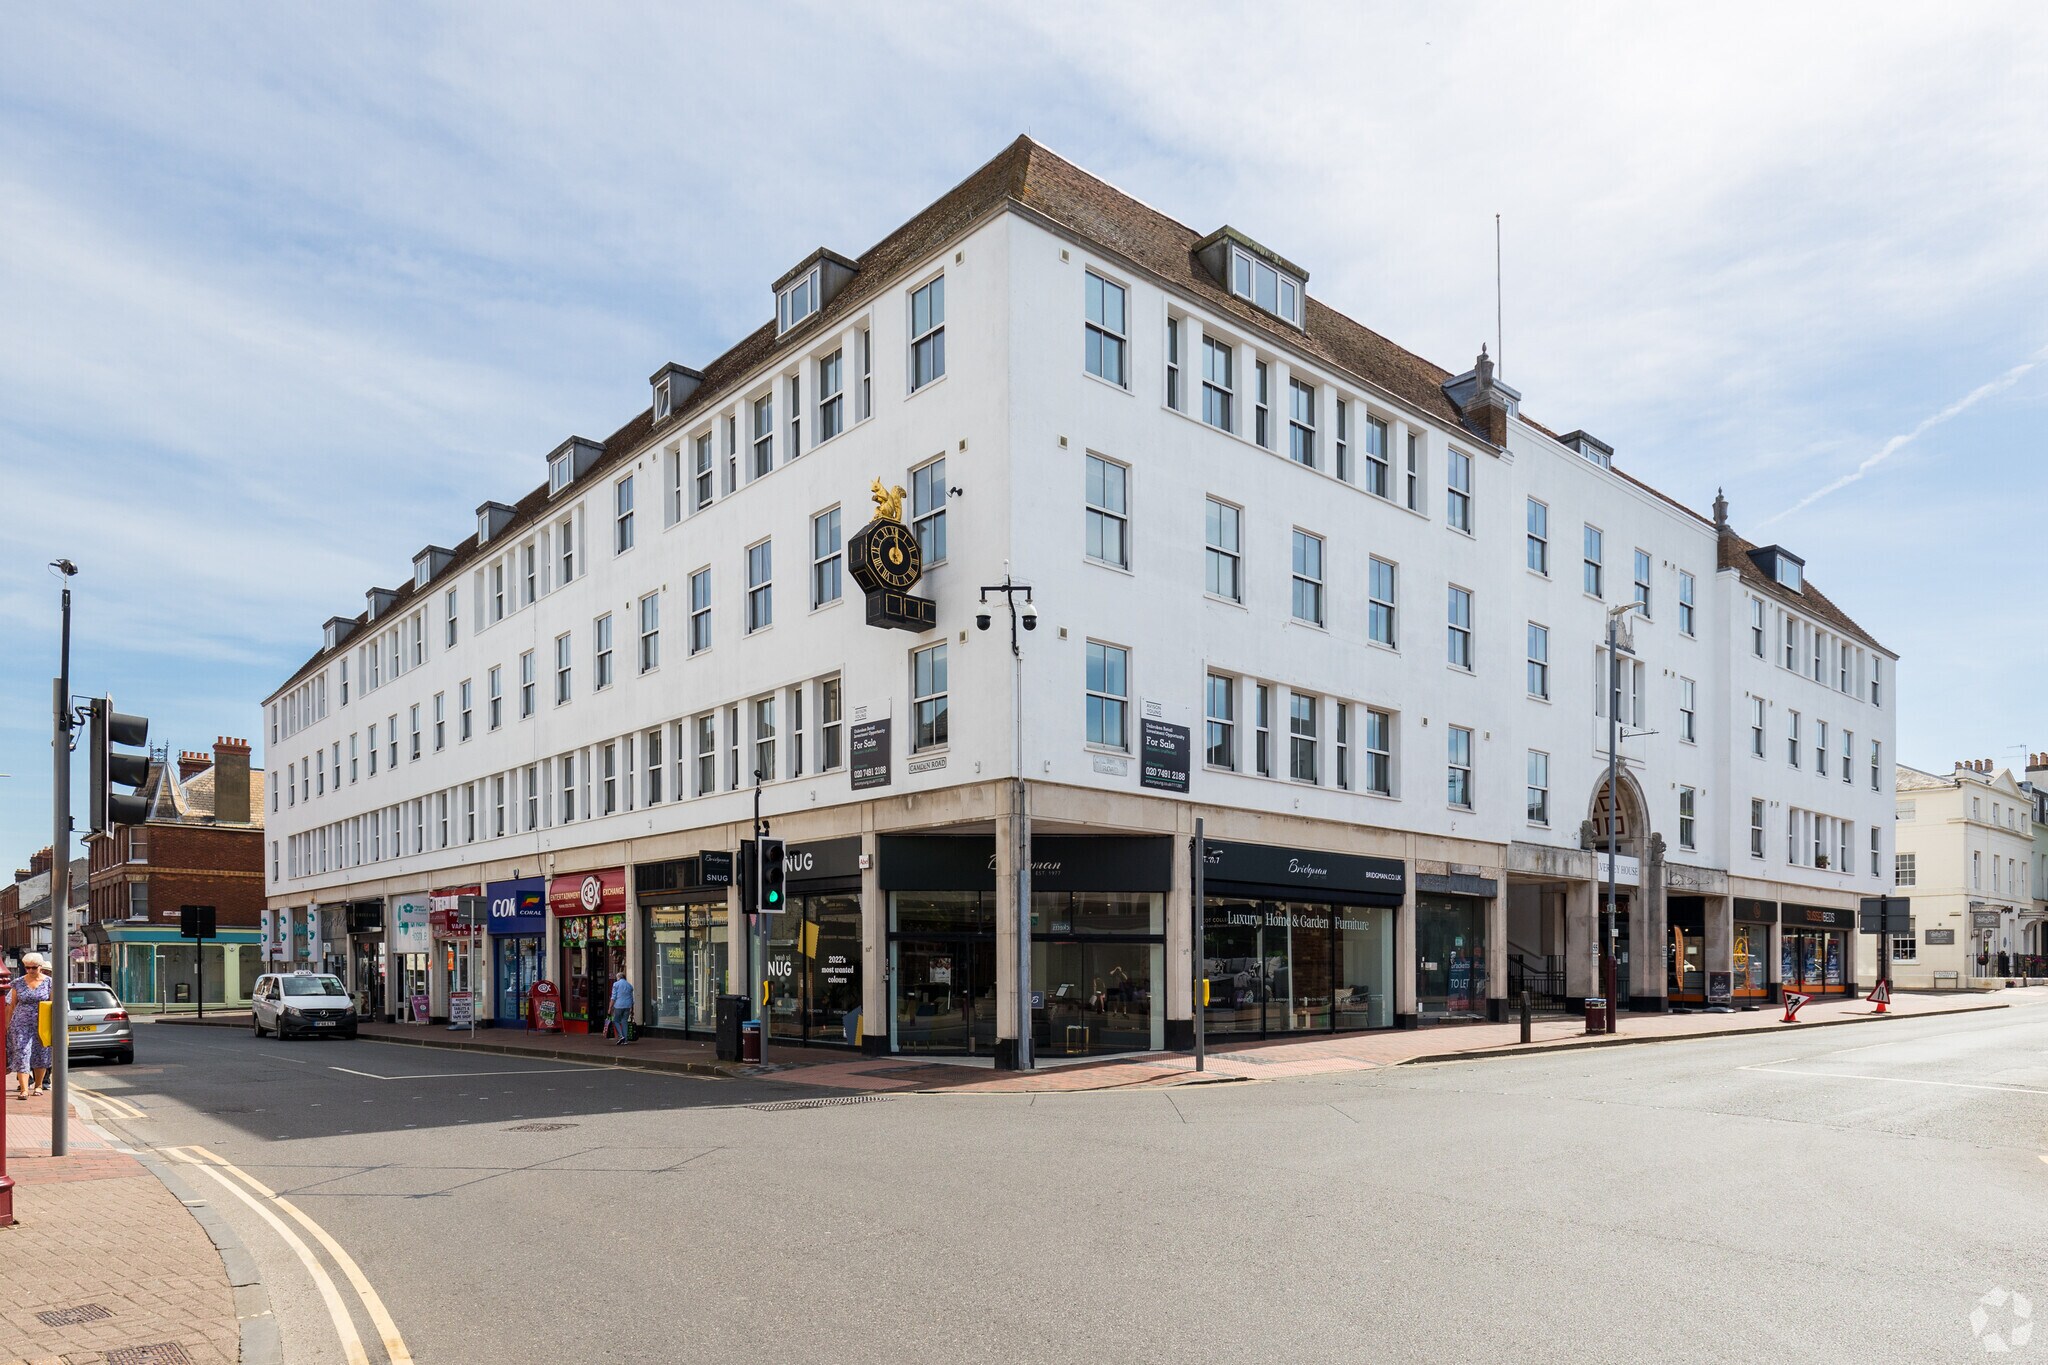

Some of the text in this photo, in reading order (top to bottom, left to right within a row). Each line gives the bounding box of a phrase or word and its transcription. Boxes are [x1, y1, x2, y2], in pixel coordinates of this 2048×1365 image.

[853, 738, 877, 750] For Sale
[1146, 736, 1158, 746] For
[1159, 739, 1175, 750] Sale
[931, 759, 946, 768] ROAD
[854, 770, 863, 779] 020
[863, 768, 874, 777] 7491
[874, 765, 887, 775] 2188
[1145, 767, 1186, 781] 020 7491 2188
[784, 852, 813, 872] NUG
[1288, 858, 1327, 879] Bridgman
[1621, 866, 1638, 876] HOUSE
[706, 874, 728, 882] SNUG
[1365, 871, 1401, 881] BRIDGMAN.CO.UK
[550, 891, 581, 901] ENTERTAINMENT
[603, 886, 625, 896] EXCHANGE
[1227, 910, 1369, 931] Luxury Home & Garden Furniture
[828, 955, 847, 964] 2022's
[767, 961, 792, 977] NUG
[834, 965, 854, 974] wanted
[828, 975, 847, 983] colours
[1450, 979, 1469, 988] TO LET
[1712, 982, 1726, 990] Sale
